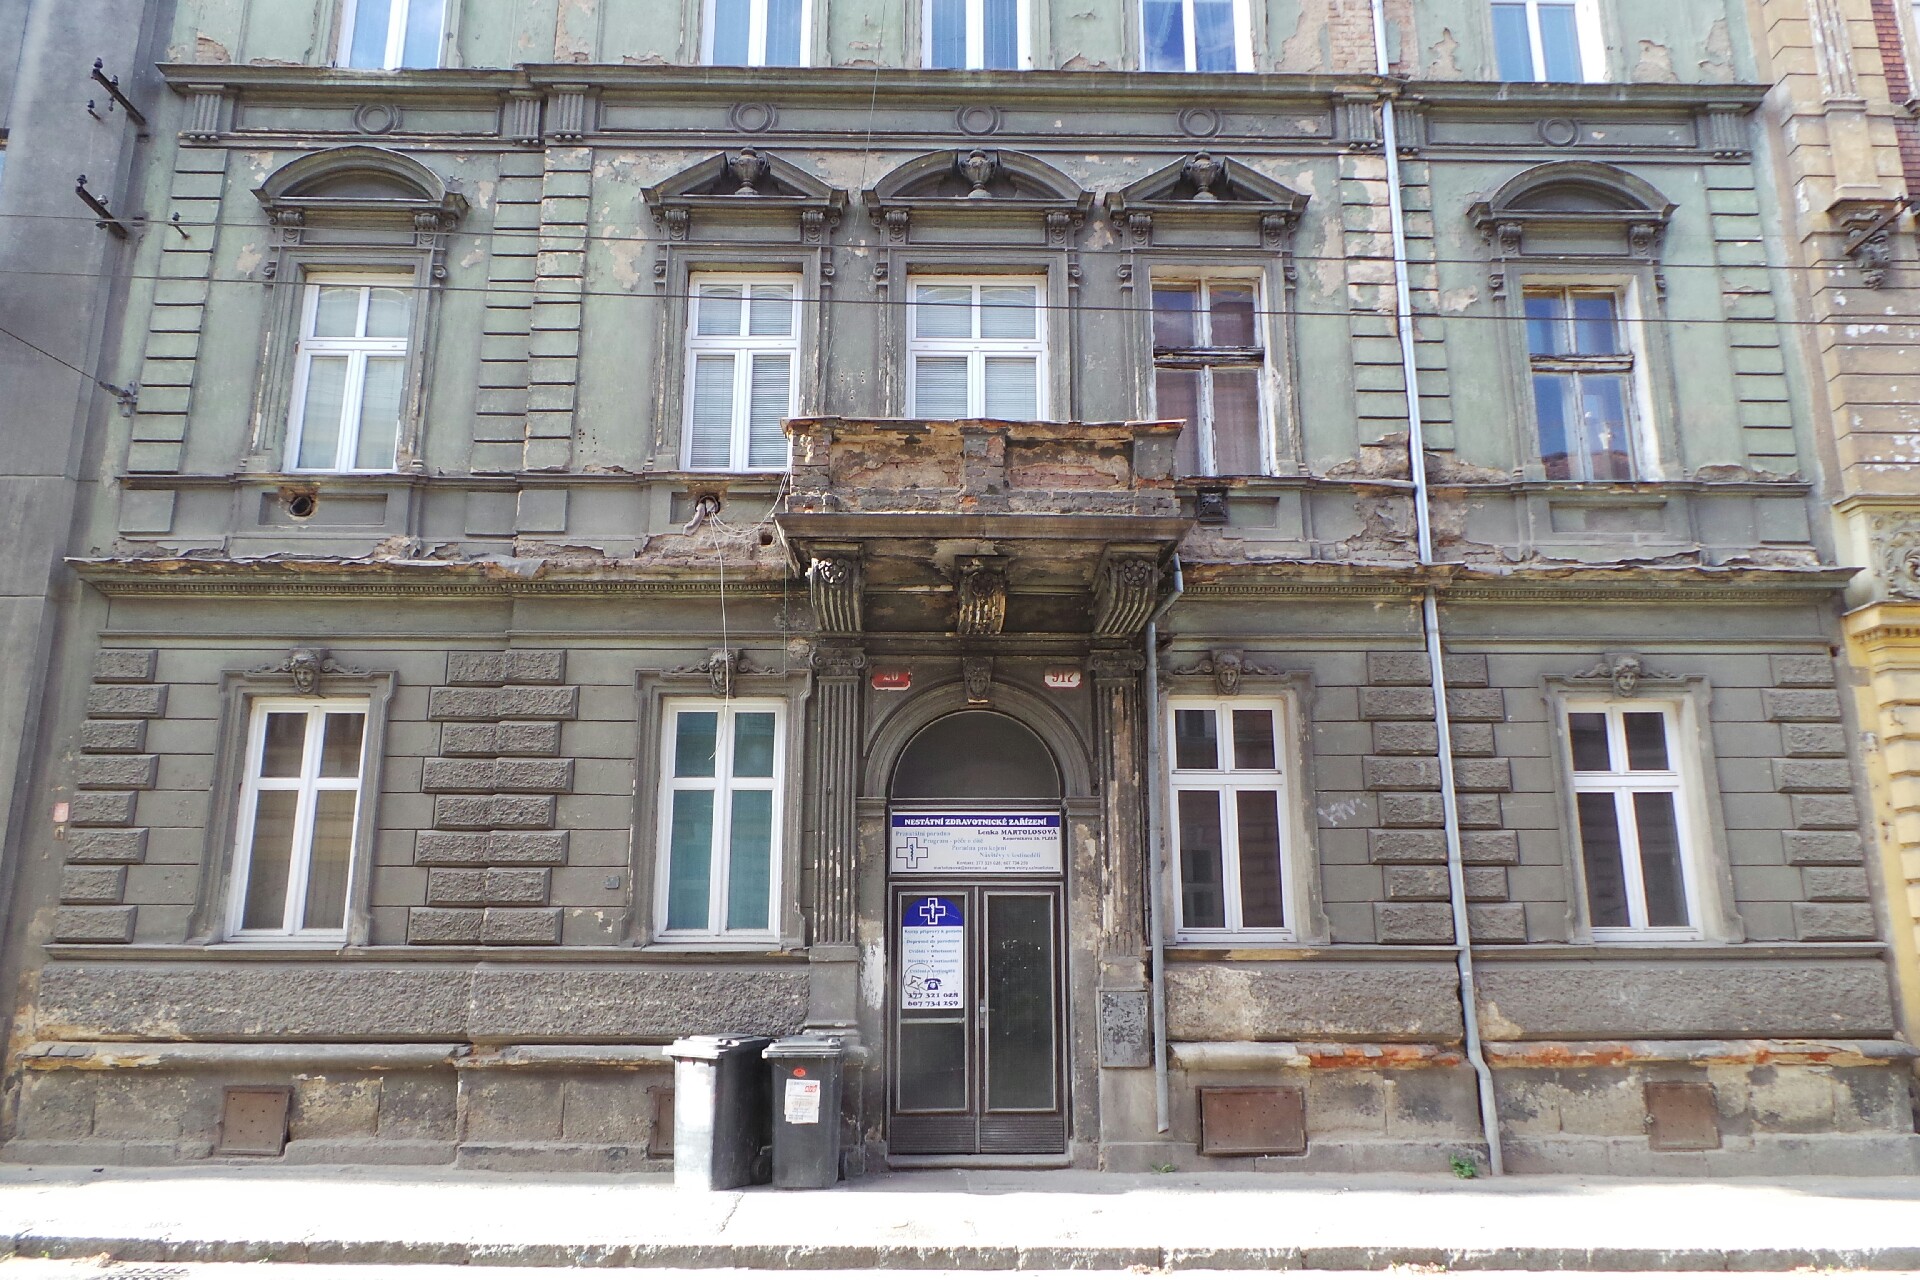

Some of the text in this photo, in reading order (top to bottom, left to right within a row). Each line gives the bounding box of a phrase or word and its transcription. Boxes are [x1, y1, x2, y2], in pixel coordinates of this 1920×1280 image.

[904, 817, 1047, 826] NESTÁTNÍ ZDRAVOTNICKÉ ZAŘÍZENÍ
[926, 830, 951, 838] poradna
